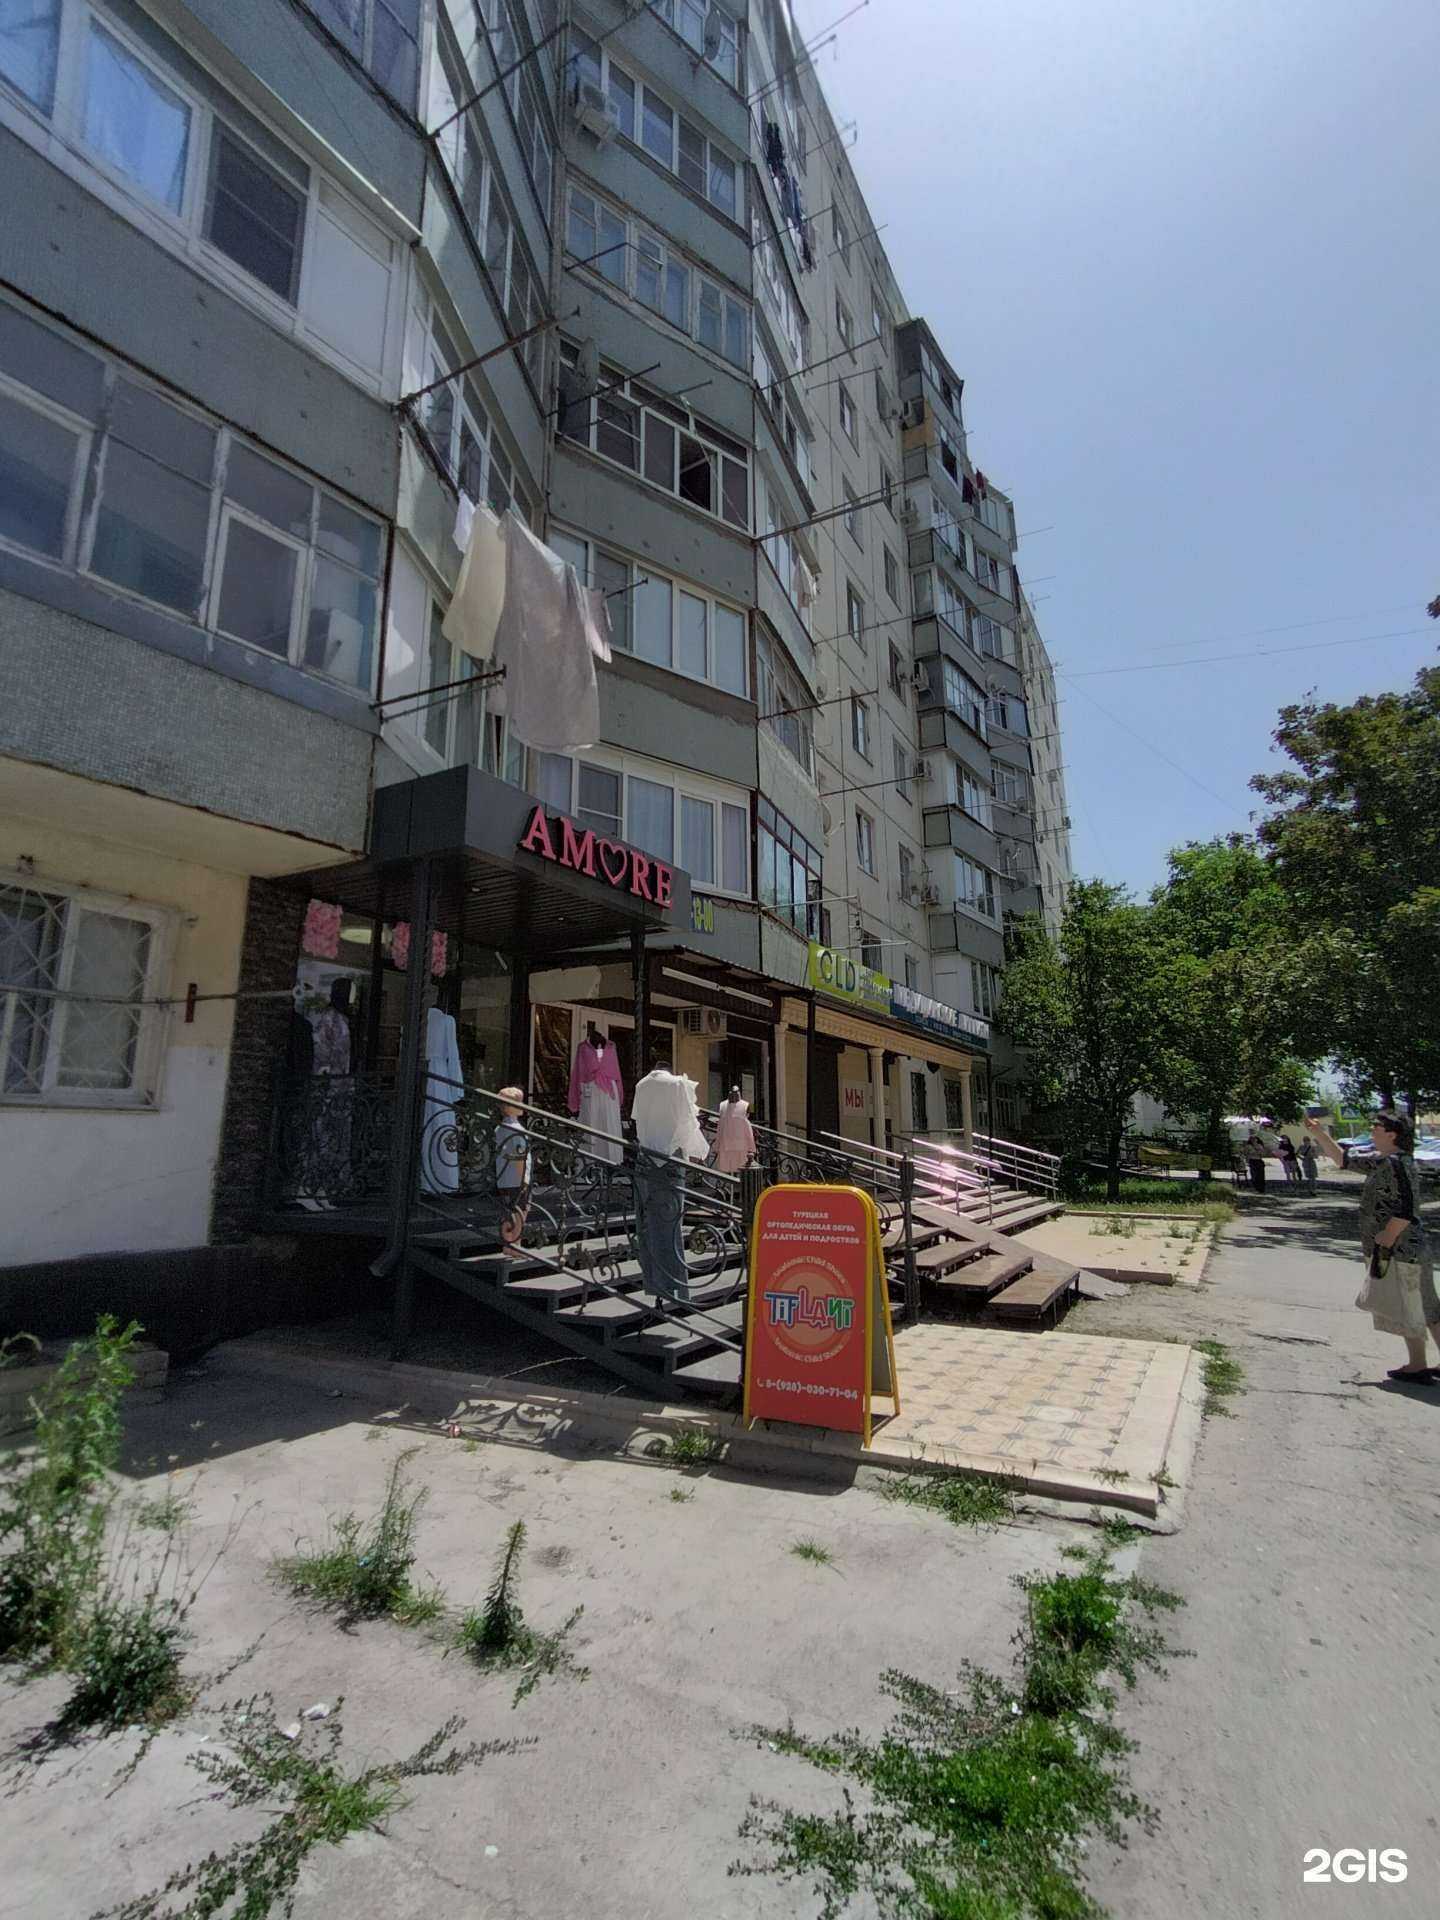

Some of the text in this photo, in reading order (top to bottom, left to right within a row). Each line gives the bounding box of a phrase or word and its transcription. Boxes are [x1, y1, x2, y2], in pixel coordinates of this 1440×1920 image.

[792, 1210, 829, 1219] ТУРЕЦКАЯ
[766, 1221, 856, 1233] ОРТОПЕДИЧЕСКАЯ ОБУВЬ
[762, 1232, 778, 1240] ДЛЯ
[778, 1231, 803, 1241] ДЕТЕЙ
[809, 1235, 860, 1244] ПОДРОСТКОВ
